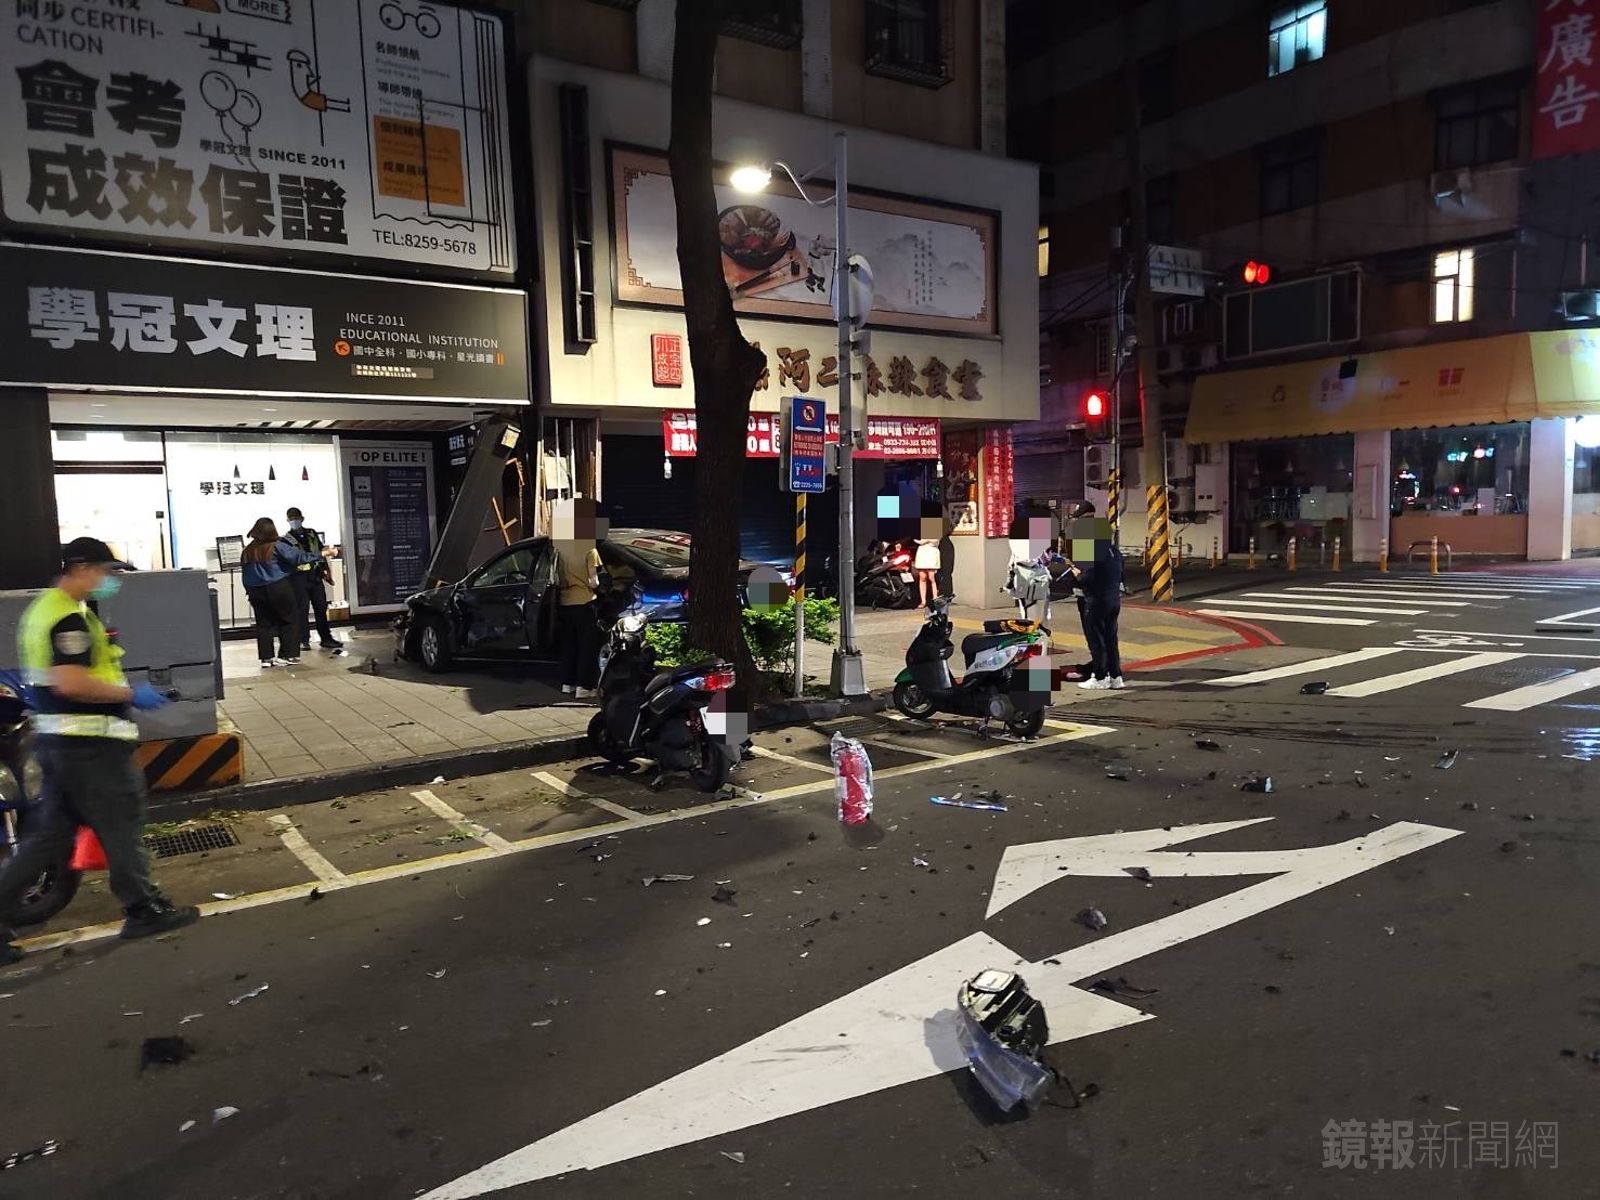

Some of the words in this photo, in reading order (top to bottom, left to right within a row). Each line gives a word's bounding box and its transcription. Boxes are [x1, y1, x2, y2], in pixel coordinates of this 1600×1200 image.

[71, 6, 164, 39] CERTIFI-
[17, 24, 104, 54] CATION
[1538, 0, 1600, 130] 廣告
[15, 59, 187, 148] 會考
[258, 147, 307, 165] SINCE
[311, 155, 346, 170] 2011
[26, 143, 350, 246] 成效保證
[372, 229, 477, 255] TEL:8259-5678
[27, 287, 318, 362] 學冠文理
[377, 315, 405, 327] 2011
[339, 329, 423, 344] EDUCATIONAL
[428, 335, 498, 349] INSTITUTION
[383, 451, 418, 463] ELITE
[200, 481, 265, 495] 學冠文理
